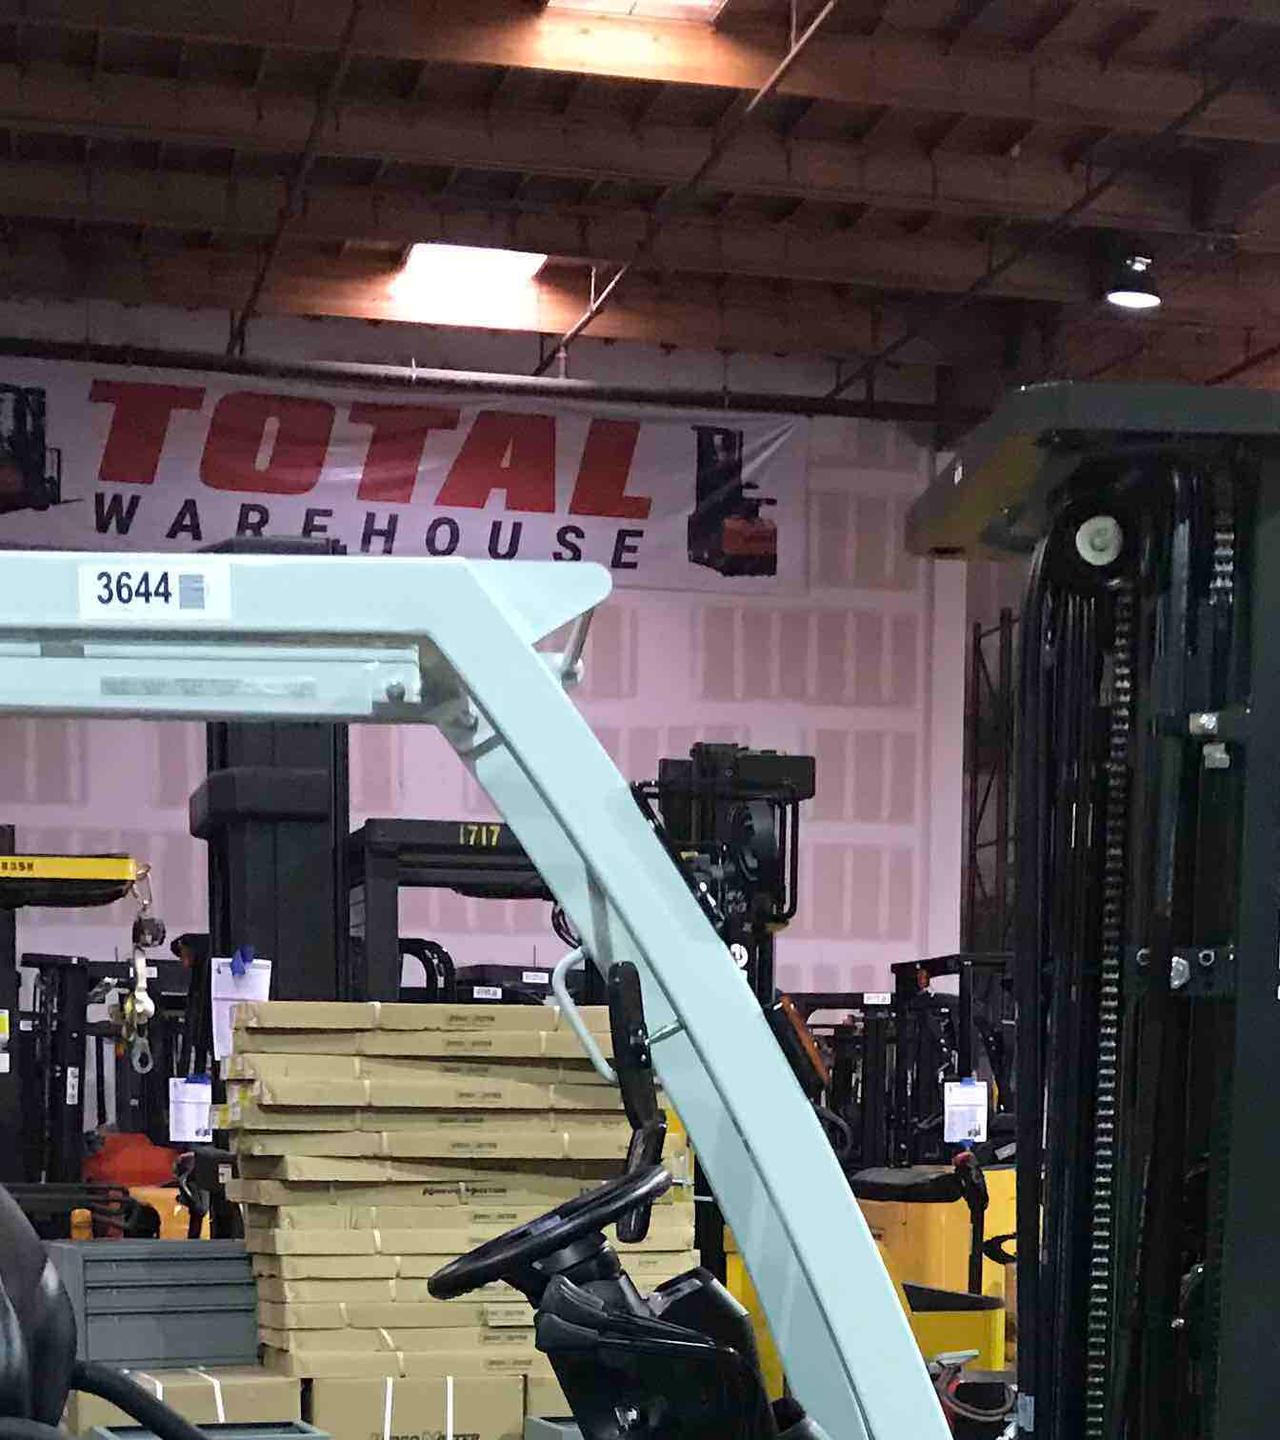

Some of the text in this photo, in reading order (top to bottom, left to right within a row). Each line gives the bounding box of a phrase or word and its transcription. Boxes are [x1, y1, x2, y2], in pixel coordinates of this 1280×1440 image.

[88, 379, 652, 519] TOTAL
[93, 492, 645, 570] WAREHOUSE
[96, 571, 173, 604] 3644
[459, 824, 501, 846] 1717
